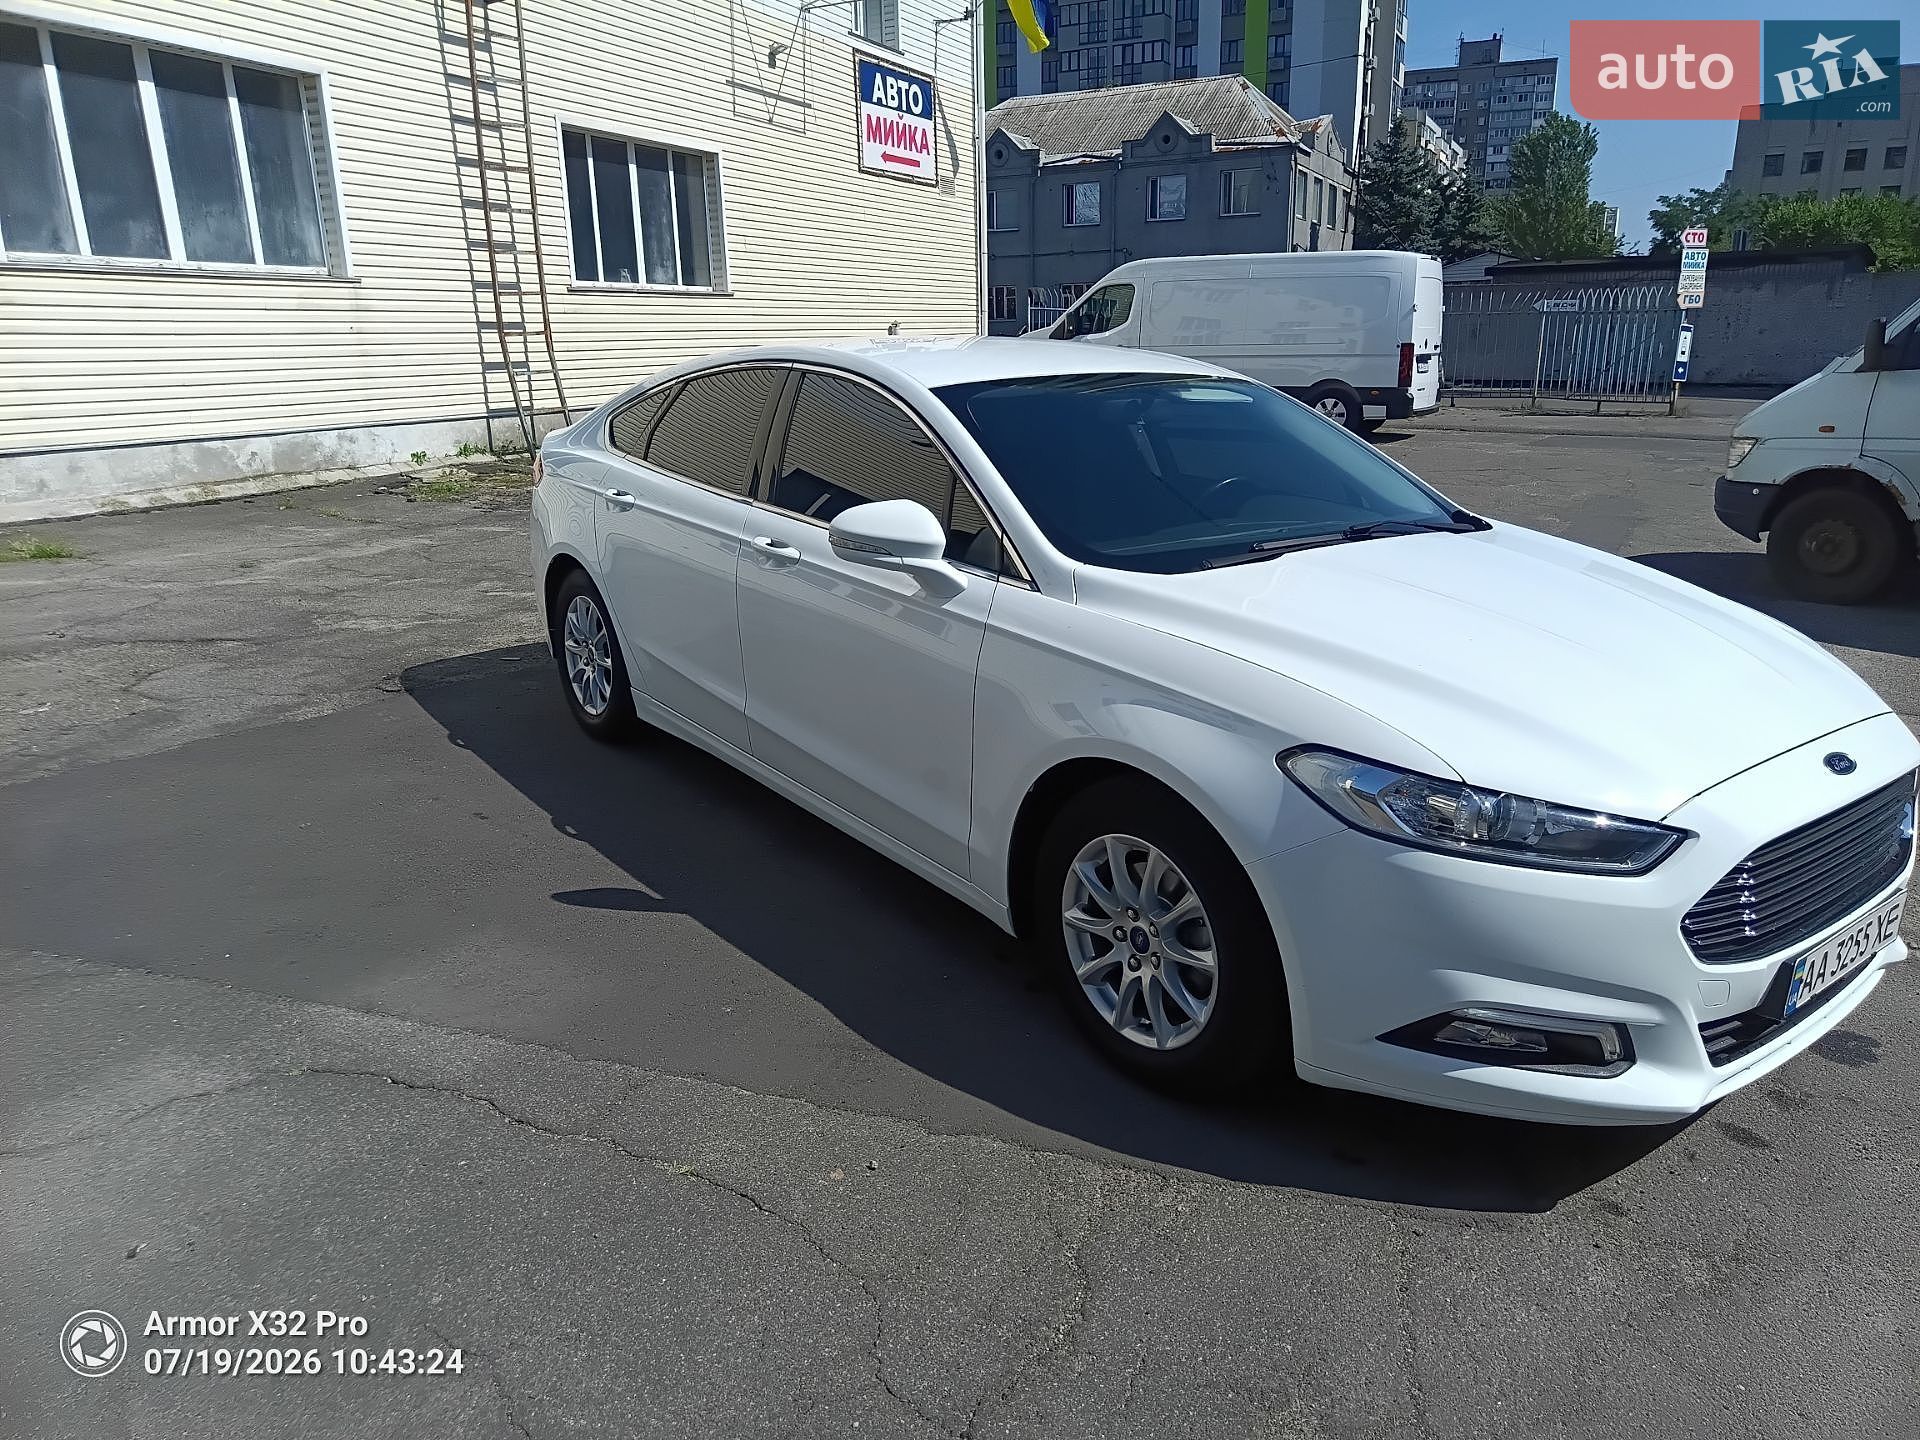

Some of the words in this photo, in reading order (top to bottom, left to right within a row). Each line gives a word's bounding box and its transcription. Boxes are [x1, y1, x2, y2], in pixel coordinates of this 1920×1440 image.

[872, 72, 923, 115] АВТО
[866, 112, 930, 156] МИЙКА
[1685, 232, 1705, 243] СТО
[1684, 251, 1707, 261] АВТО
[1683, 294, 1701, 305] ГБО
[1830, 755, 1850, 771] Ford
[1799, 950, 1829, 1000] AA
[1830, 919, 1873, 977] 3255
[1871, 903, 1900, 949] XE
